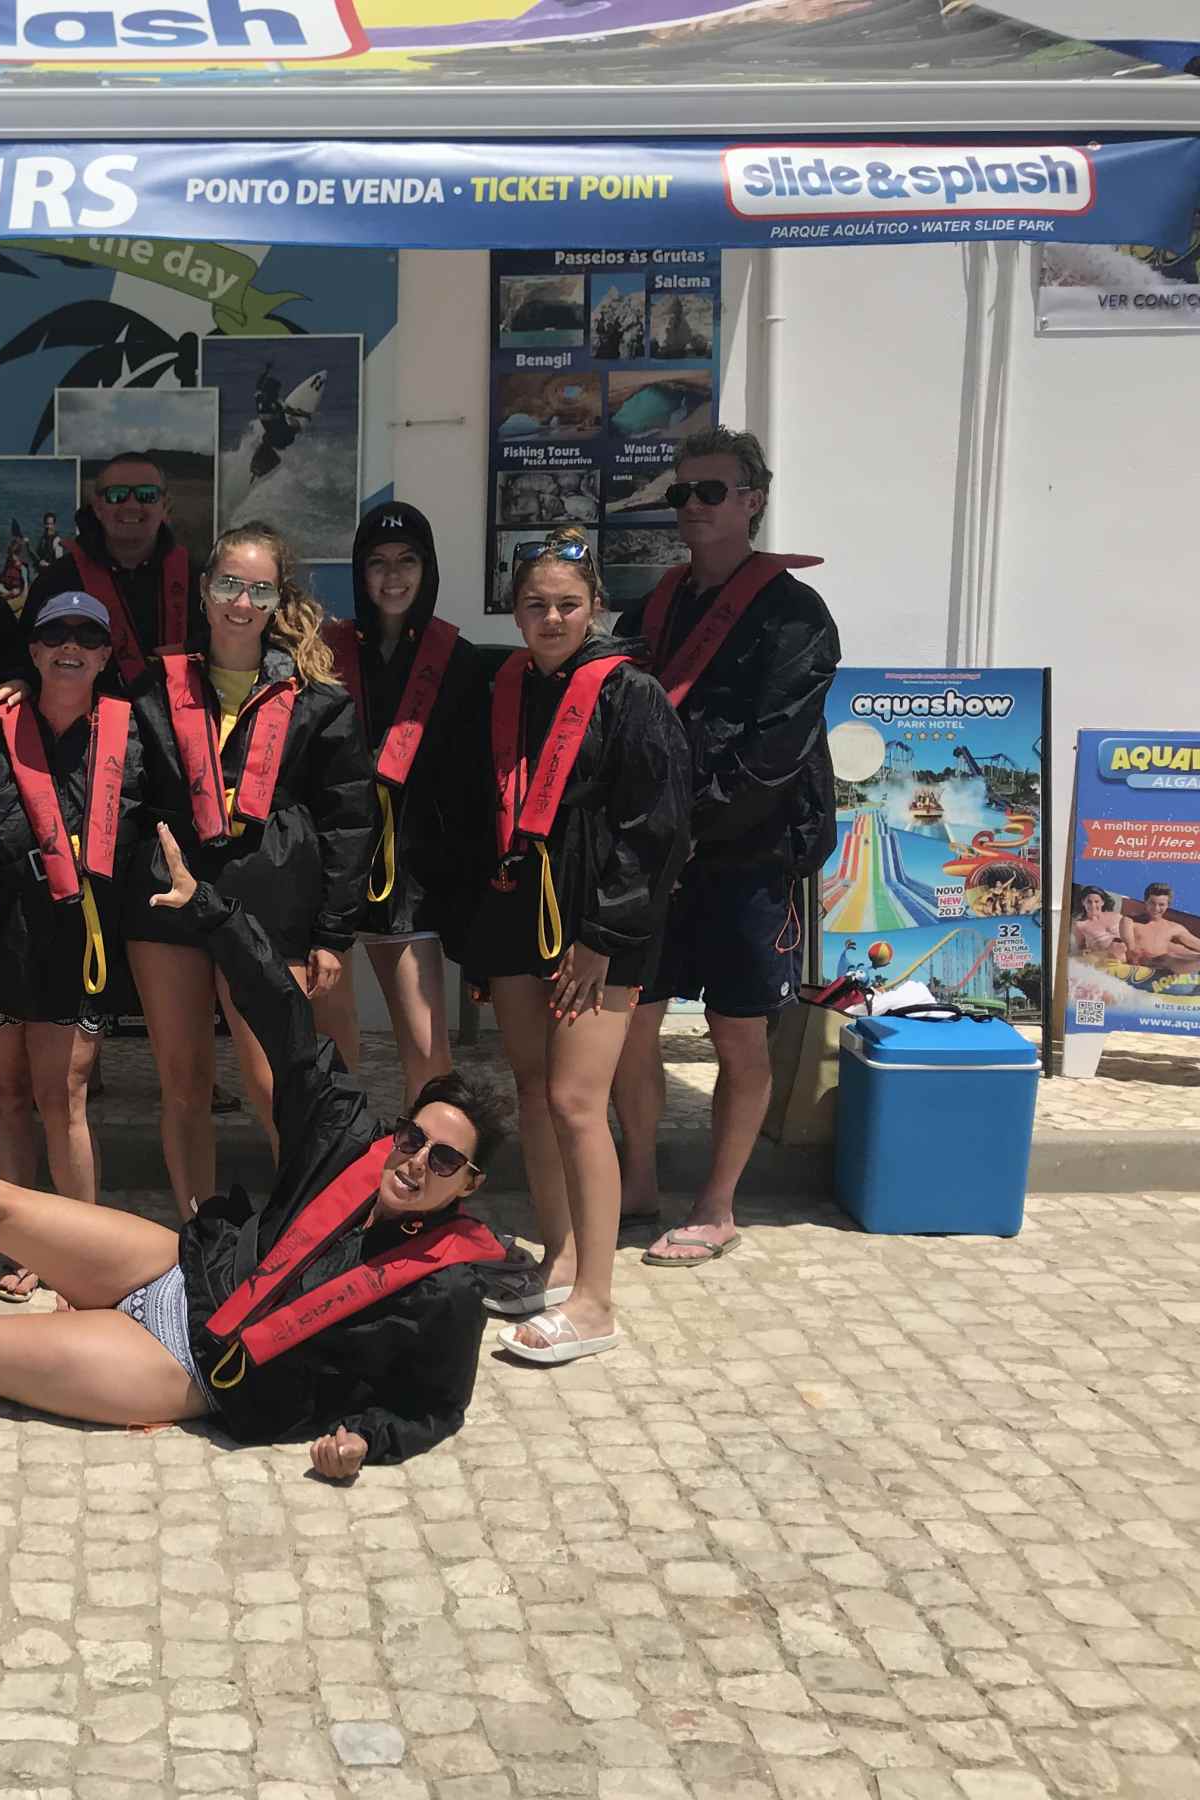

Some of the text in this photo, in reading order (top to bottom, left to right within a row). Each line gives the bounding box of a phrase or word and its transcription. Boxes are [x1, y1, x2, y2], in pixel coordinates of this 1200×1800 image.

[742, 154, 1078, 204] slide&splash
[186, 174, 673, 206] PONTO DE VENDA TICKET POINT
[770, 218, 1055, 239] PARQUE AQUÁTICO WATER SLIDE PARK
[554, 250, 625, 265] Passeios
[652, 249, 706, 264] Grutas
[163, 244, 241, 299] day
[654, 274, 711, 289] Salema
[1097, 293, 1129, 308] VER
[515, 352, 573, 369] Benagil
[503, 446, 581, 461] Fishing Tours
[623, 443, 659, 455] Water
[523, 457, 548, 466] Pesca
[615, 455, 633, 464] Taxi
[851, 688, 1015, 722] aquashow
[897, 719, 965, 729] PARK HOTEL
[1091, 820, 1101, 831] A
[1104, 820, 1148, 832] melhor
[1114, 834, 1148, 848] Aqui
[1158, 836, 1195, 849] Here
[1091, 847, 1114, 858] The
[1117, 847, 1145, 859] best
[935, 886, 963, 896] NOVO
[938, 896, 962, 906] NEW
[938, 907, 964, 917] 2017
[998, 924, 1020, 938] 32
